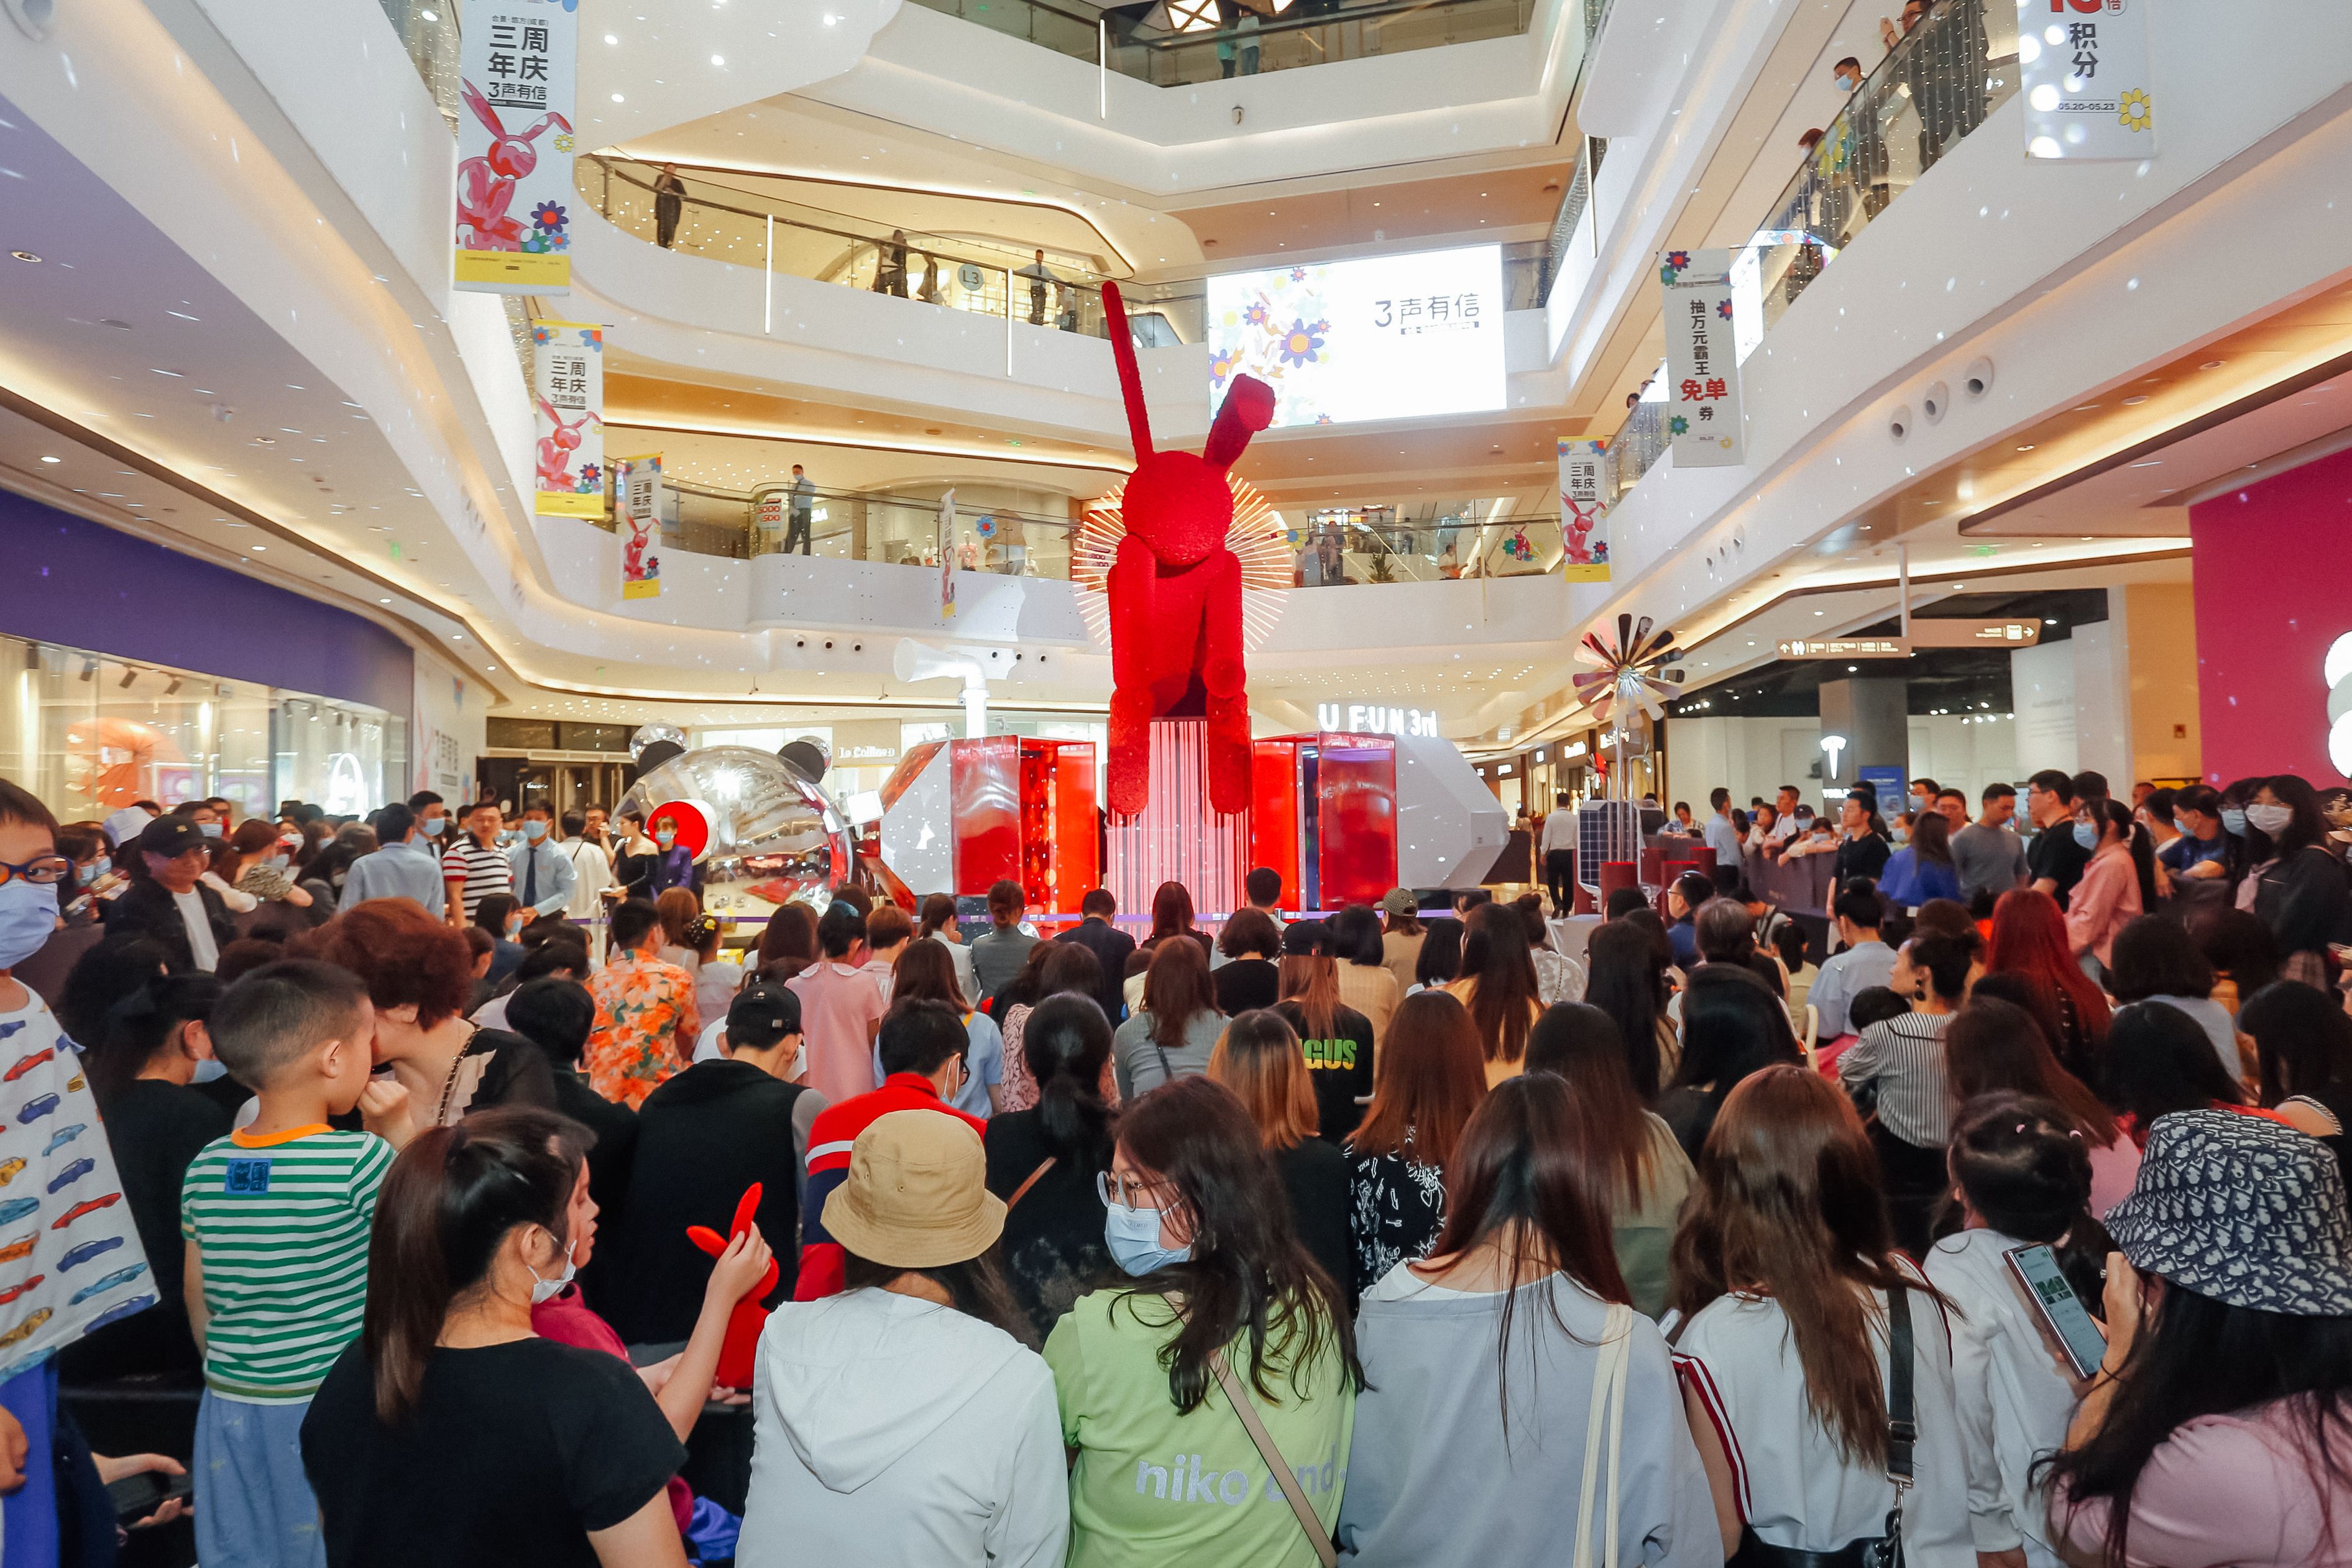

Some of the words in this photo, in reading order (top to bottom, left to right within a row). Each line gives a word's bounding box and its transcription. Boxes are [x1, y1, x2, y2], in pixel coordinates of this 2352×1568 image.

[489, 25, 548, 53] 三周
[2069, 22, 2098, 78] 积分
[488, 52, 548, 81] 年庆
[963, 270, 979, 285] L3
[1375, 293, 1479, 328] 3声有信
[1690, 300, 1710, 375] 抽万元霸王
[551, 360, 585, 377] 三周
[551, 377, 586, 393] 年庆
[1680, 378, 1728, 401] 免单
[1699, 406, 1714, 421] 券
[1571, 465, 1595, 477] 三周
[1571, 478, 1596, 489] 年庆
[1318, 704, 1339, 732] U
[1349, 705, 1404, 735] FUN
[1408, 708, 1438, 738] 3rd
[1136, 1454, 1248, 1506] niko
